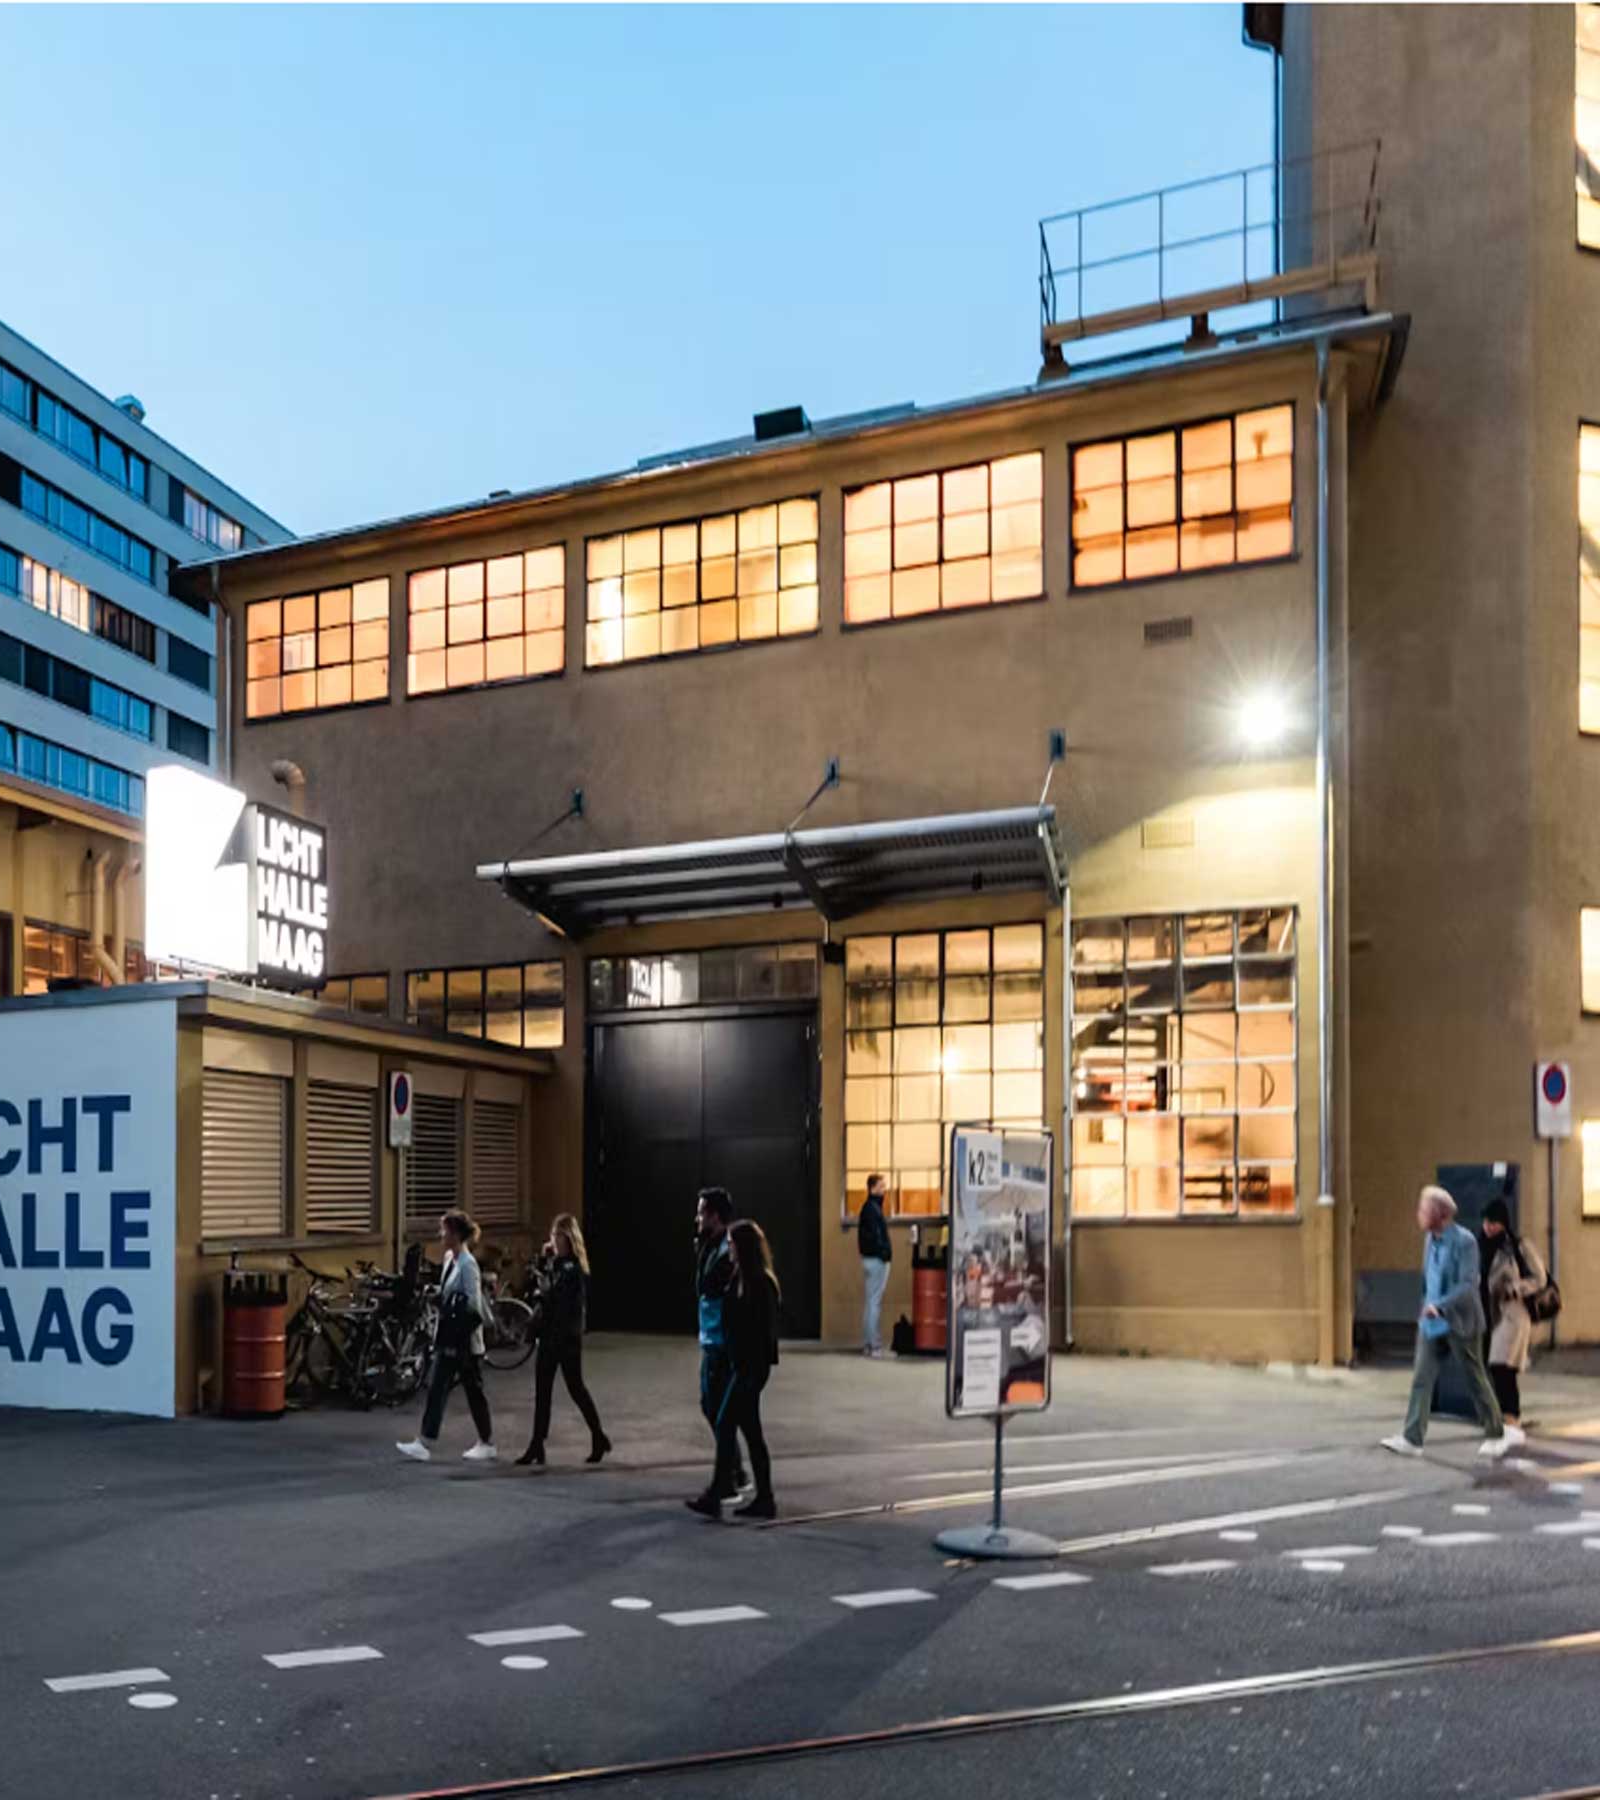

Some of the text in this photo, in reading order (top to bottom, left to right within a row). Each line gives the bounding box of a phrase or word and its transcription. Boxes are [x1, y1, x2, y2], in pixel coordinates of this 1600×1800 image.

[257, 812, 323, 878] LICHT
[257, 866, 328, 930] HALLE
[257, 918, 324, 978] MAAG
